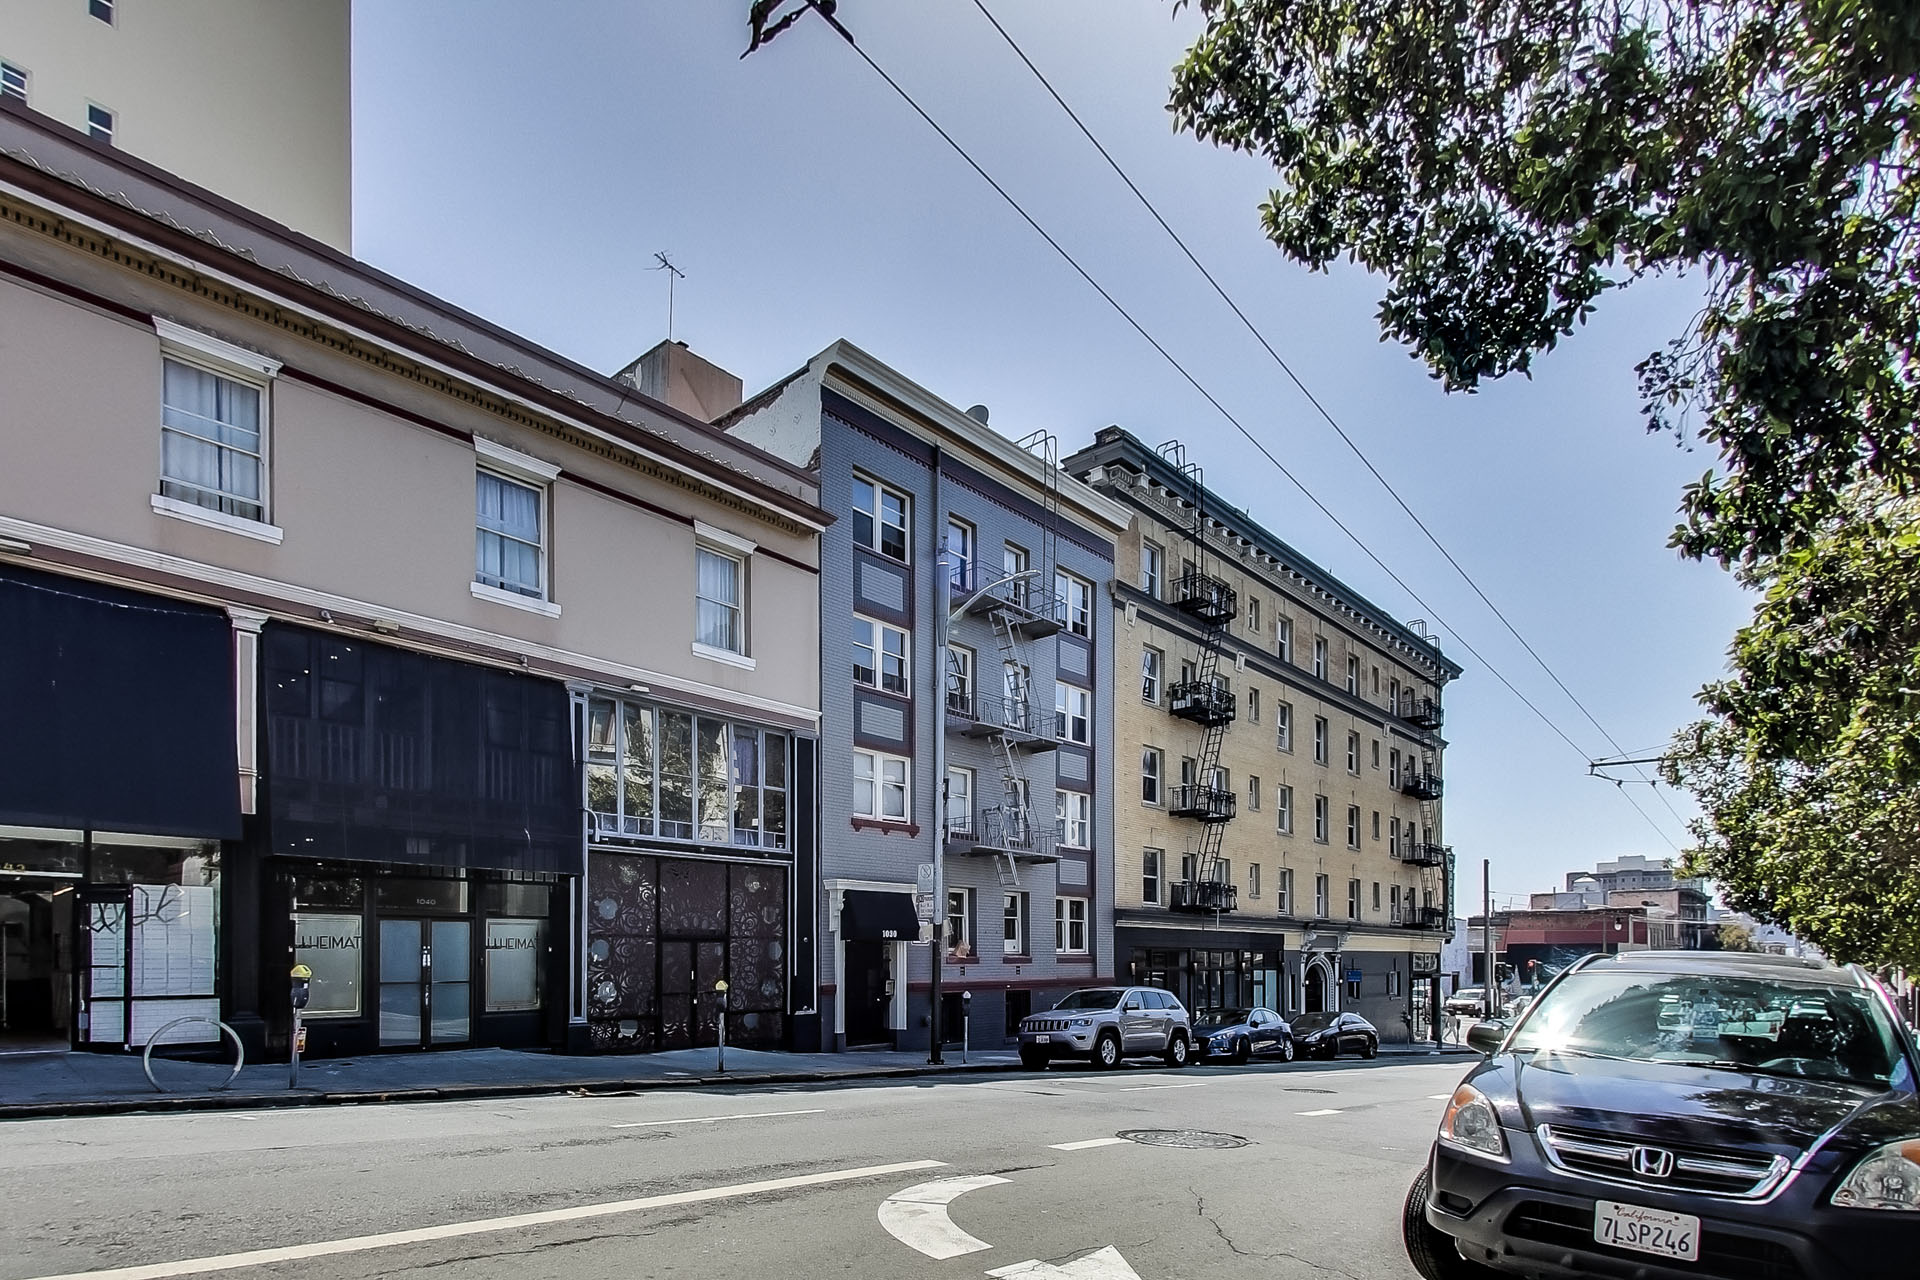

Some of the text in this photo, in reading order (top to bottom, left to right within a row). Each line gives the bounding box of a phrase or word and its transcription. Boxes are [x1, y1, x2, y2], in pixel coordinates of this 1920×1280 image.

[416, 898, 437, 906] 1040
[882, 930, 897, 938] 1030
[1616, 1207, 1679, 1227] California
[1602, 1216, 1691, 1252] 7LSP246
